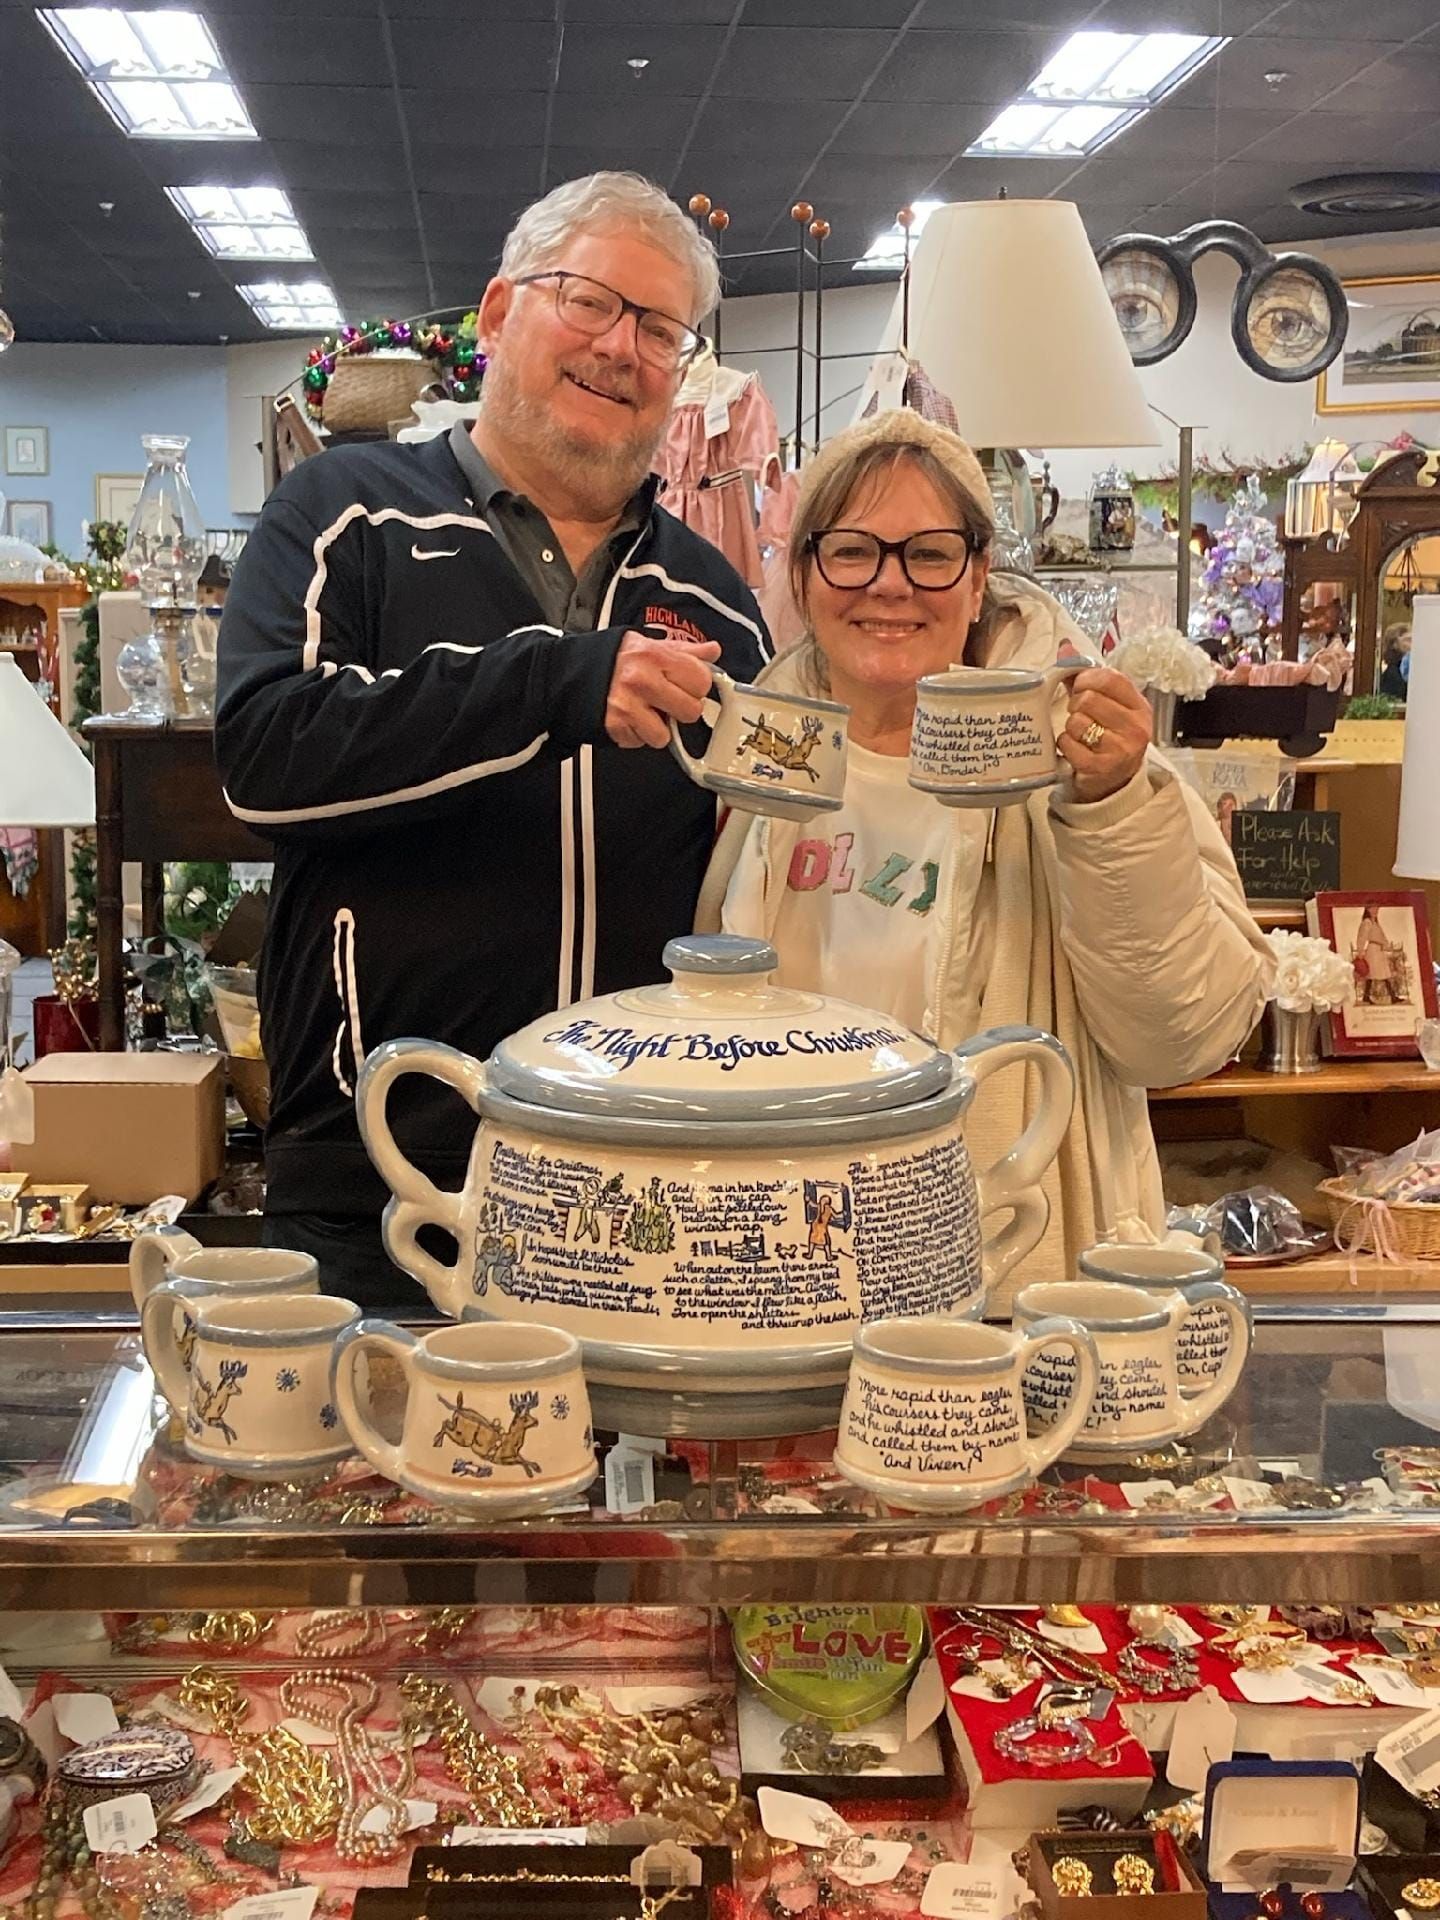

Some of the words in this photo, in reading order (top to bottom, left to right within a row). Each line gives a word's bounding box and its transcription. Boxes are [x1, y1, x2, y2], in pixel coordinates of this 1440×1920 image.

[930, 714, 962, 728] rapid
[964, 713, 996, 726] than
[998, 711, 1033, 729] eagles
[966, 725, 995, 742] they
[924, 738, 970, 752] whistled
[973, 736, 998, 751] and
[999, 734, 1042, 748] shouted
[919, 751, 949, 762] called
[951, 753, 981, 764] them
[982, 750, 1005, 767] by
[1236, 812, 1293, 842] Please
[1298, 816, 1335, 845] Ask
[1238, 846, 1276, 870] For
[1281, 843, 1320, 877] Help
[787, 832, 940, 918] OLL
[543, 1020, 602, 1046] The
[586, 1026, 683, 1072] Night
[678, 1029, 789, 1071] Before
[667, 1182, 690, 1193] And
[725, 1182, 736, 1193] in
[737, 1181, 755, 1193] her
[672, 1194, 694, 1204] and
[725, 1193, 747, 1204] my
[675, 1204, 697, 1214] Had
[763, 1203, 787, 1212] our
[681, 1211, 720, 1223] brains
[719, 1212, 739, 1227] for
[752, 1212, 787, 1227] long
[590, 1251, 635, 1266] Nicholas
[673, 1261, 705, 1273] When
[706, 1264, 721, 1275] out
[722, 1266, 736, 1275] on
[736, 1264, 752, 1275] the
[753, 1261, 780, 1275] lawn
[781, 1262, 806, 1273] there
[808, 1263, 836, 1271] arose
[615, 1281, 629, 1292] all
[662, 1274, 689, 1283] such
[690, 1275, 698, 1284] a
[747, 1275, 783, 1288] sprang
[784, 1273, 805, 1287] from
[806, 1273, 820, 1285] my
[822, 1267, 840, 1280] bed
[664, 1285, 676, 1296] to
[676, 1287, 692, 1296] see
[694, 1284, 725, 1296] what
[725, 1287, 745, 1296] was
[745, 1286, 764, 1296] the
[764, 1283, 805, 1296] matter
[674, 1297, 687, 1307] to
[688, 1296, 705, 1307] the
[706, 1297, 751, 1308] window
[762, 1297, 784, 1312] flew
[785, 1296, 806, 1307] like
[671, 1307, 699, 1318] Tore
[700, 1310, 728, 1324] open
[728, 1309, 747, 1318] the
[747, 1310, 800, 1321] shutters
[741, 1319, 764, 1330] and
[767, 1317, 800, 1329] threw
[801, 1318, 814, 1328] up
[814, 1312, 831, 1324] the
[1037, 1352, 1077, 1371] rapid
[1121, 1356, 1162, 1375] eagles
[1029, 1365, 1077, 1383] courser
[858, 1376, 888, 1397] More
[891, 1389, 936, 1407] rapid
[938, 1389, 976, 1403] than
[980, 1386, 1012, 1407] eagles
[1029, 1380, 1072, 1399] whistl
[1122, 1382, 1168, 1400] shouted
[862, 1393, 882, 1414] his
[882, 1404, 939, 1420] coursers
[942, 1405, 976, 1427] they
[1101, 1401, 1126, 1421] by
[867, 1415, 882, 1432] he
[884, 1420, 948, 1438] whistled
[951, 1422, 981, 1438] and
[982, 1415, 1019, 1435] shouted
[872, 1435, 917, 1451] called
[920, 1437, 959, 1452] them
[962, 1436, 987, 1461] by
[764, 1604, 870, 1628] Brighton
[792, 1622, 912, 1665] LOVE
